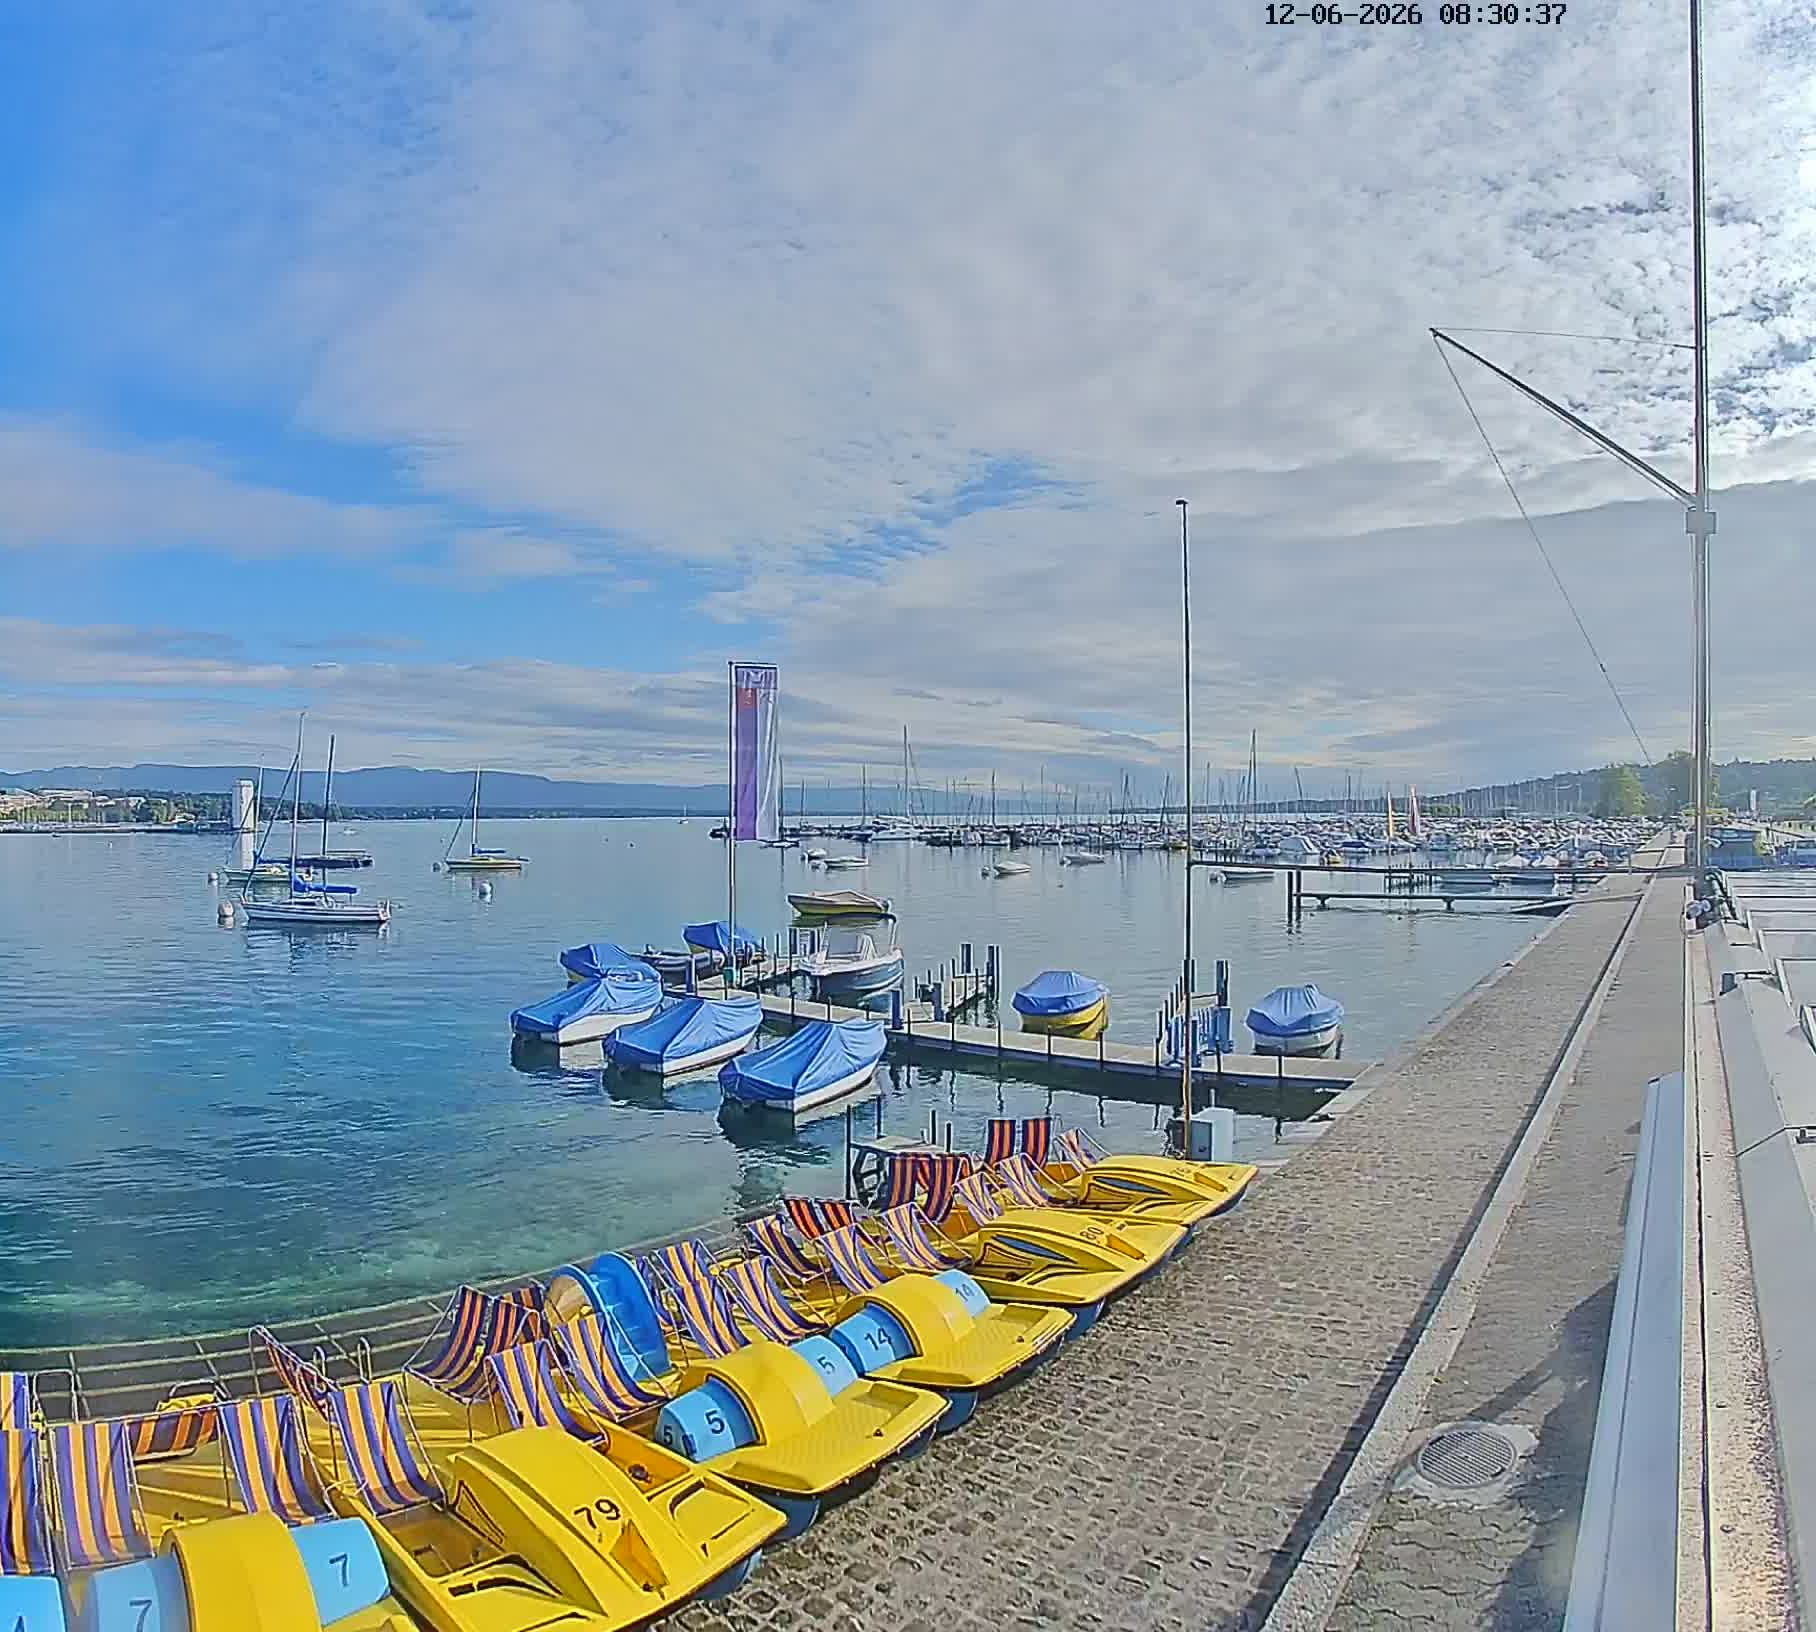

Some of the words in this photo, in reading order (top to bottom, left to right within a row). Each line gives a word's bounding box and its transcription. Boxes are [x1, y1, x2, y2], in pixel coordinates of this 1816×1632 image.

[864, 1327, 892, 1351] 14
[817, 1356, 835, 1375] 5
[705, 1409, 725, 1434] 5
[664, 1424, 673, 1445] 5
[574, 1499, 621, 1529] 79
[329, 1554, 348, 1587] 7
[129, 1599, 153, 1632] 7
